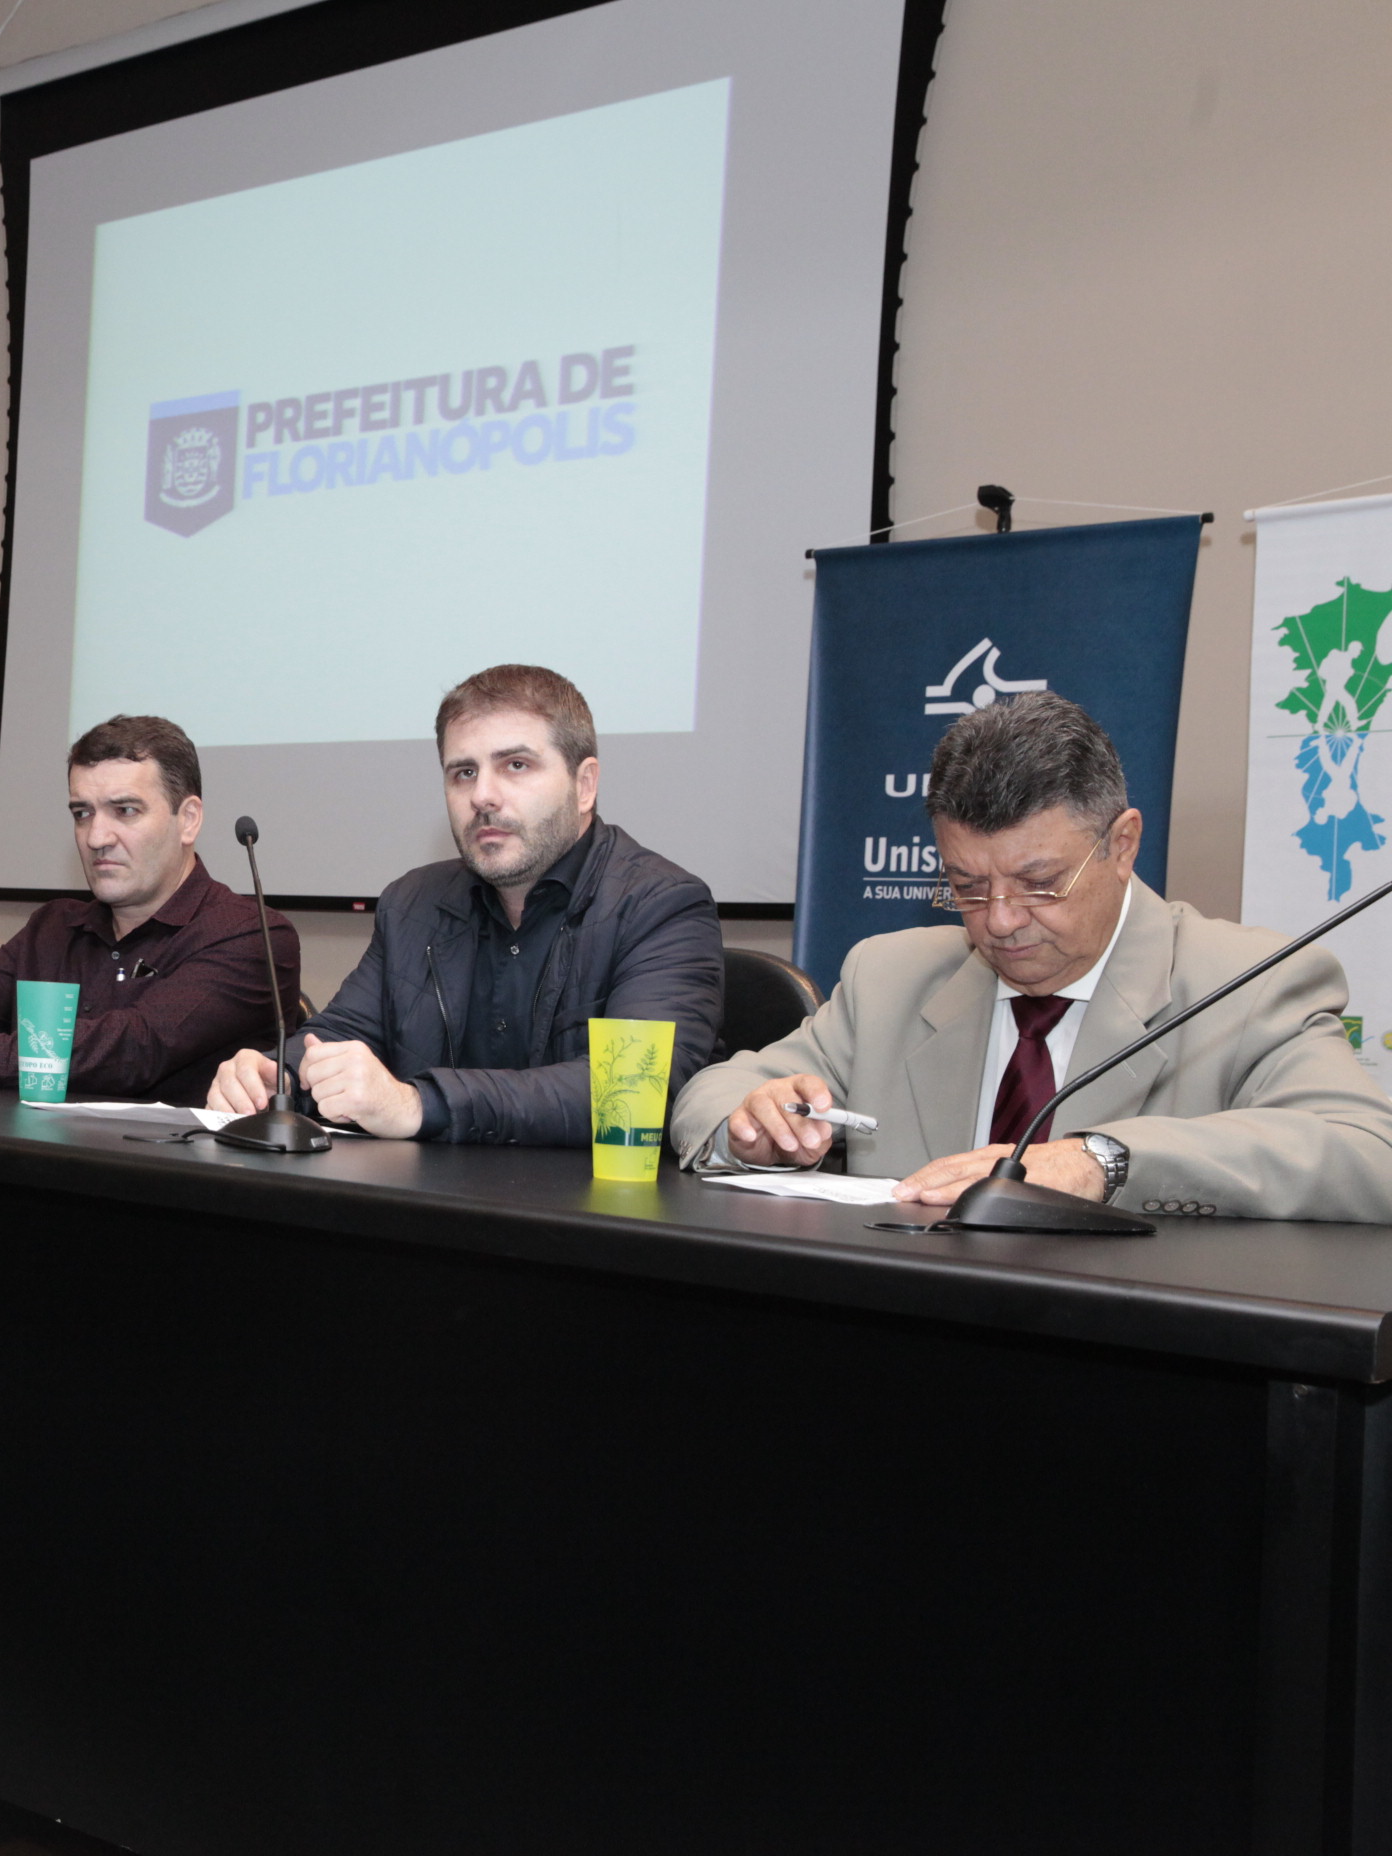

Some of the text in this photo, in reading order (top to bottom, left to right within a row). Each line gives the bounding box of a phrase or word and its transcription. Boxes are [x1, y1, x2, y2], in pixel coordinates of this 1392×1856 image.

[245, 344, 636, 450] PREFEITURA DE
[241, 402, 638, 500] FLORIANÓPOLIS
[863, 885, 874, 899] A
[875, 885, 902, 900] SUA
